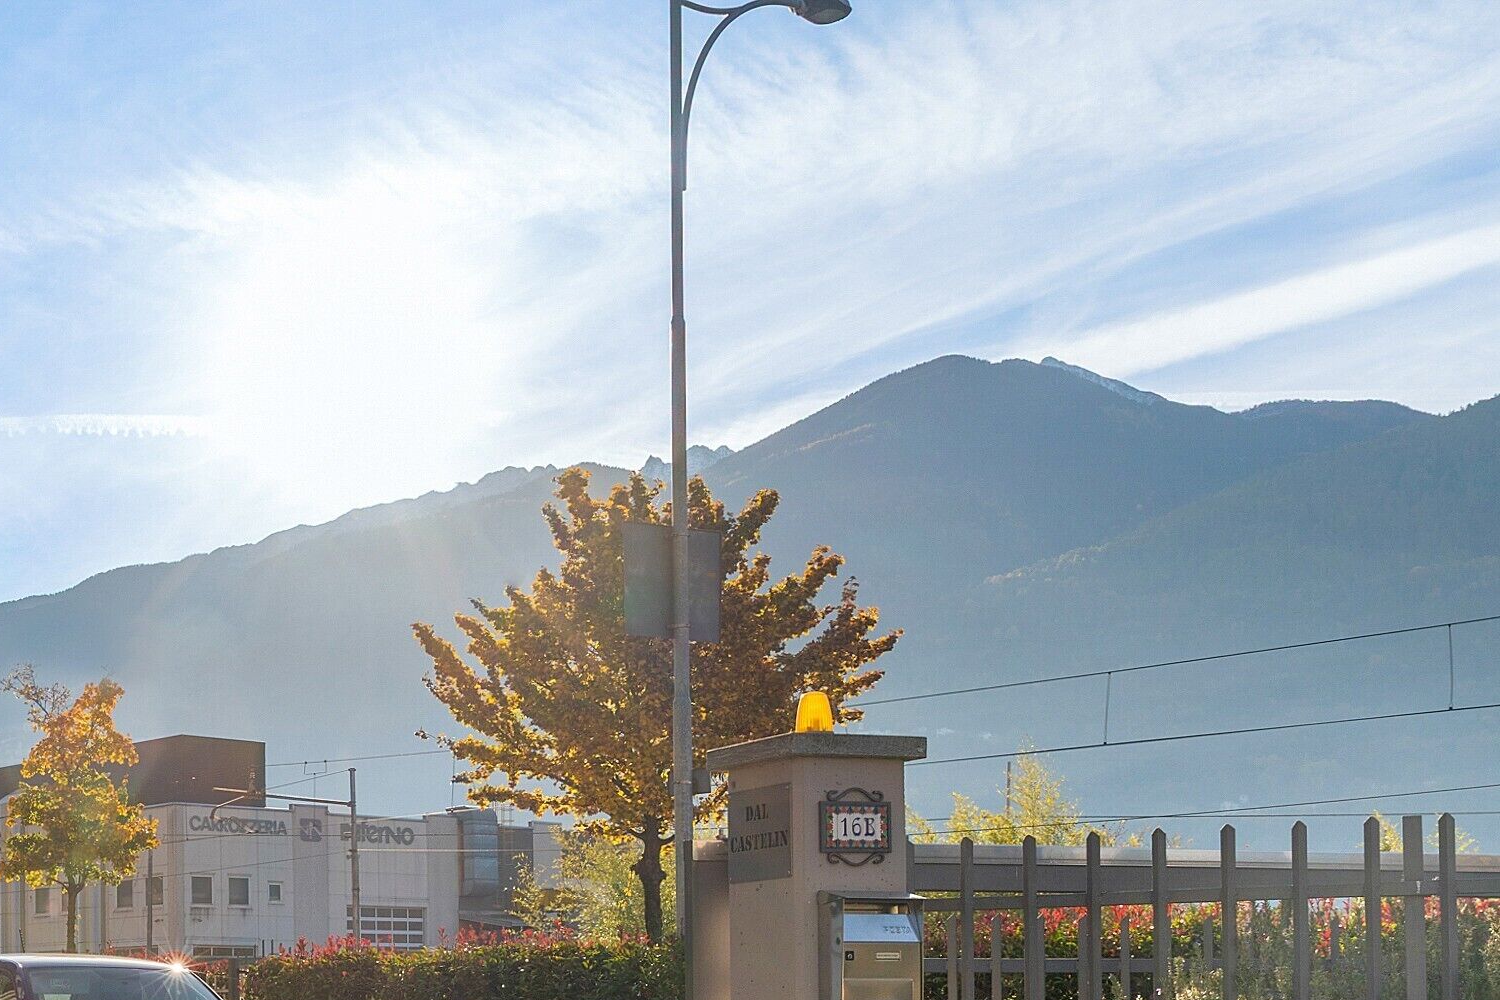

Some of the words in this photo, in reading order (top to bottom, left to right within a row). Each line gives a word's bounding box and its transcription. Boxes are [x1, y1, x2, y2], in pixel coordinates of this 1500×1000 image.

[745, 803, 769, 822] DAL
[840, 817, 876, 838] 16B
[730, 829, 789, 854] CASTELIN
